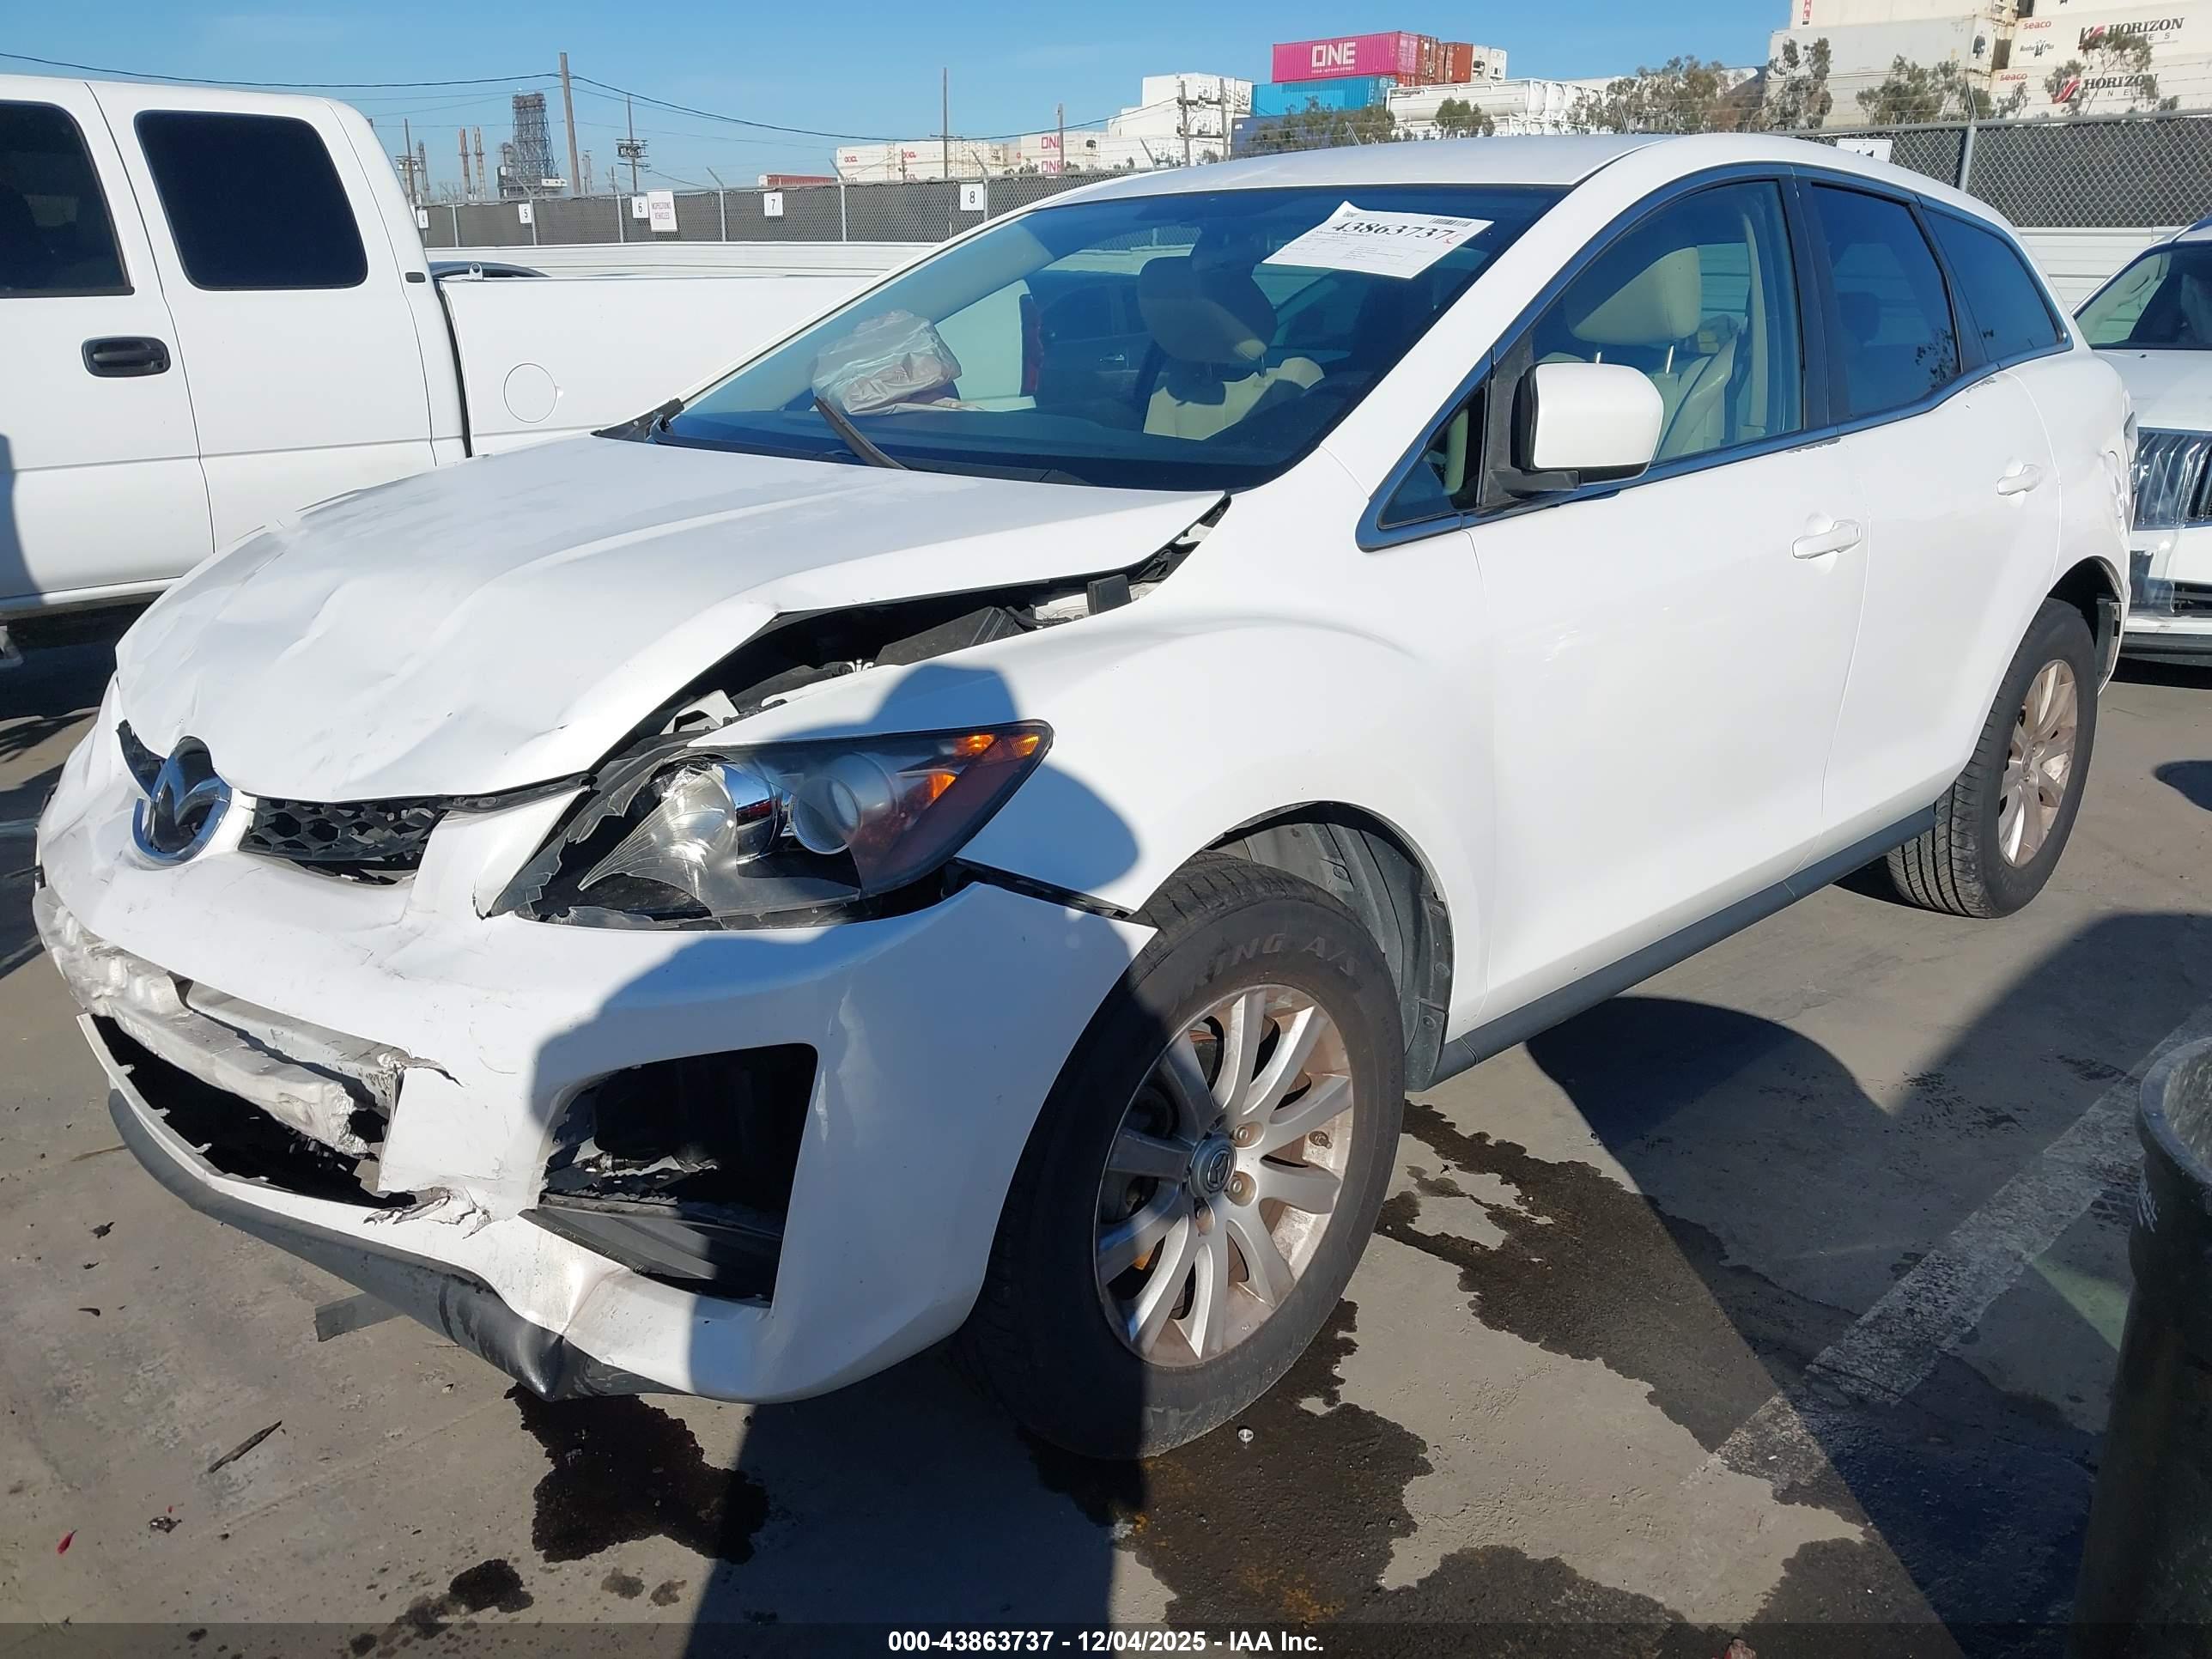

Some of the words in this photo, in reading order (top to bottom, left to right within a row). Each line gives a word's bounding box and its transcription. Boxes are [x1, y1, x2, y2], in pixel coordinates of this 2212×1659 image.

[2023, 21, 2051, 29] seaco
[2108, 17, 2185, 35] HORIZON
[1311, 41, 1356, 68] ONE
[969, 191, 975, 204] 8
[638, 202, 643, 213] 6
[770, 198, 776, 210] 7
[523, 207, 528, 219] 5
[1332, 222, 1457, 240] 43863737
